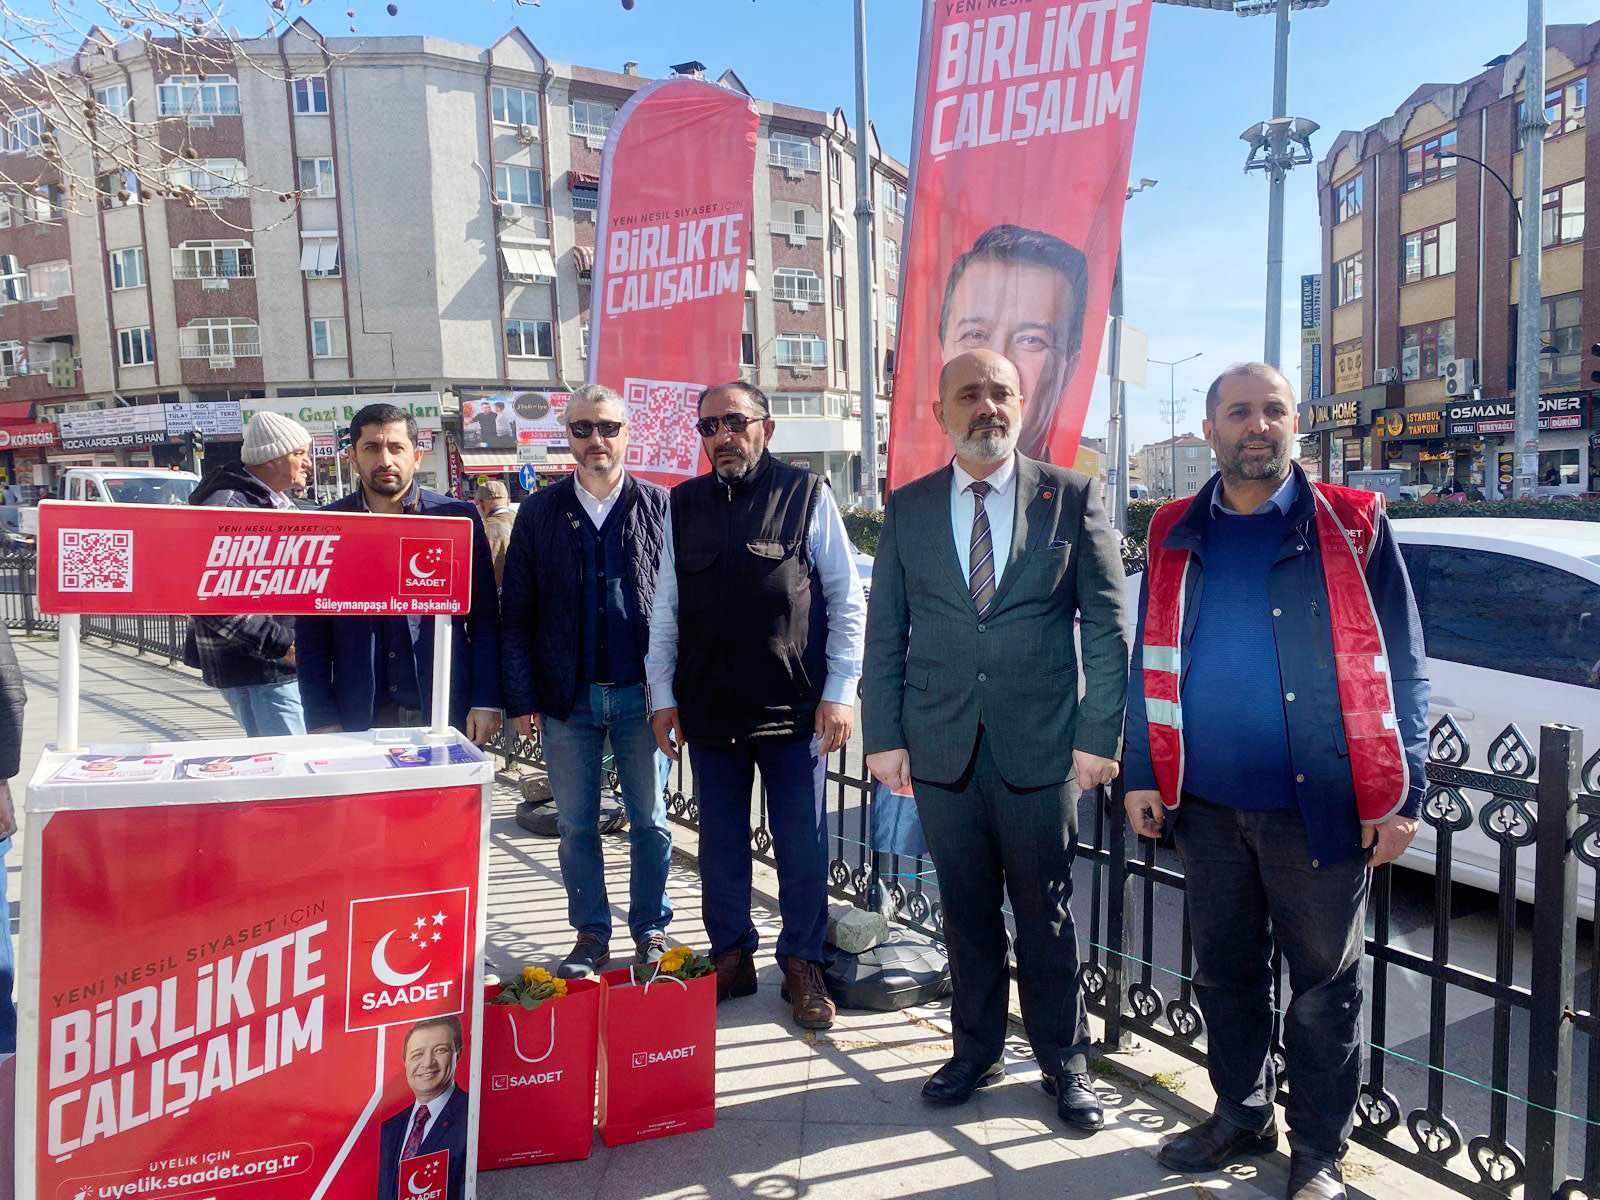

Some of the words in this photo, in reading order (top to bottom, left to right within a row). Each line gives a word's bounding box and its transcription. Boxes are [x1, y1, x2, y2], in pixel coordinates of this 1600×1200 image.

[936, 0, 1143, 93] BİRLİKTE
[930, 65, 1135, 162] ÇALIŞALIM
[608, 213, 744, 274] BİRLİKTE
[606, 258, 740, 320] ÇALIŞALIM
[299, 405, 337, 422] Gazi
[1332, 401, 1358, 421] HOME
[1450, 403, 1516, 419] OSMANL
[85, 436, 134, 448] KARDEŞLER
[144, 432, 165, 443] HANI
[1453, 424, 1474, 433] SOSLU
[205, 534, 341, 568] BİRLİKTE
[197, 567, 331, 601] ÇALIŞALIM
[405, 578, 446, 587] SAADET
[314, 597, 388, 612] Süleymanpaşa
[390, 595, 409, 612] İlçe
[411, 598, 461, 612] Başkanlığı
[113, 956, 178, 989] NESİL
[186, 918, 276, 962] SİYASET
[48, 919, 328, 1090] BİRLİKTE
[361, 980, 453, 1011] SAADET
[648, 1045, 697, 1064] SAADET
[47, 994, 324, 1163] ÇALIŞALIM
[509, 1070, 564, 1088] SAADET
[98, 1153, 300, 1200] uyelik.saadet.org.tr
